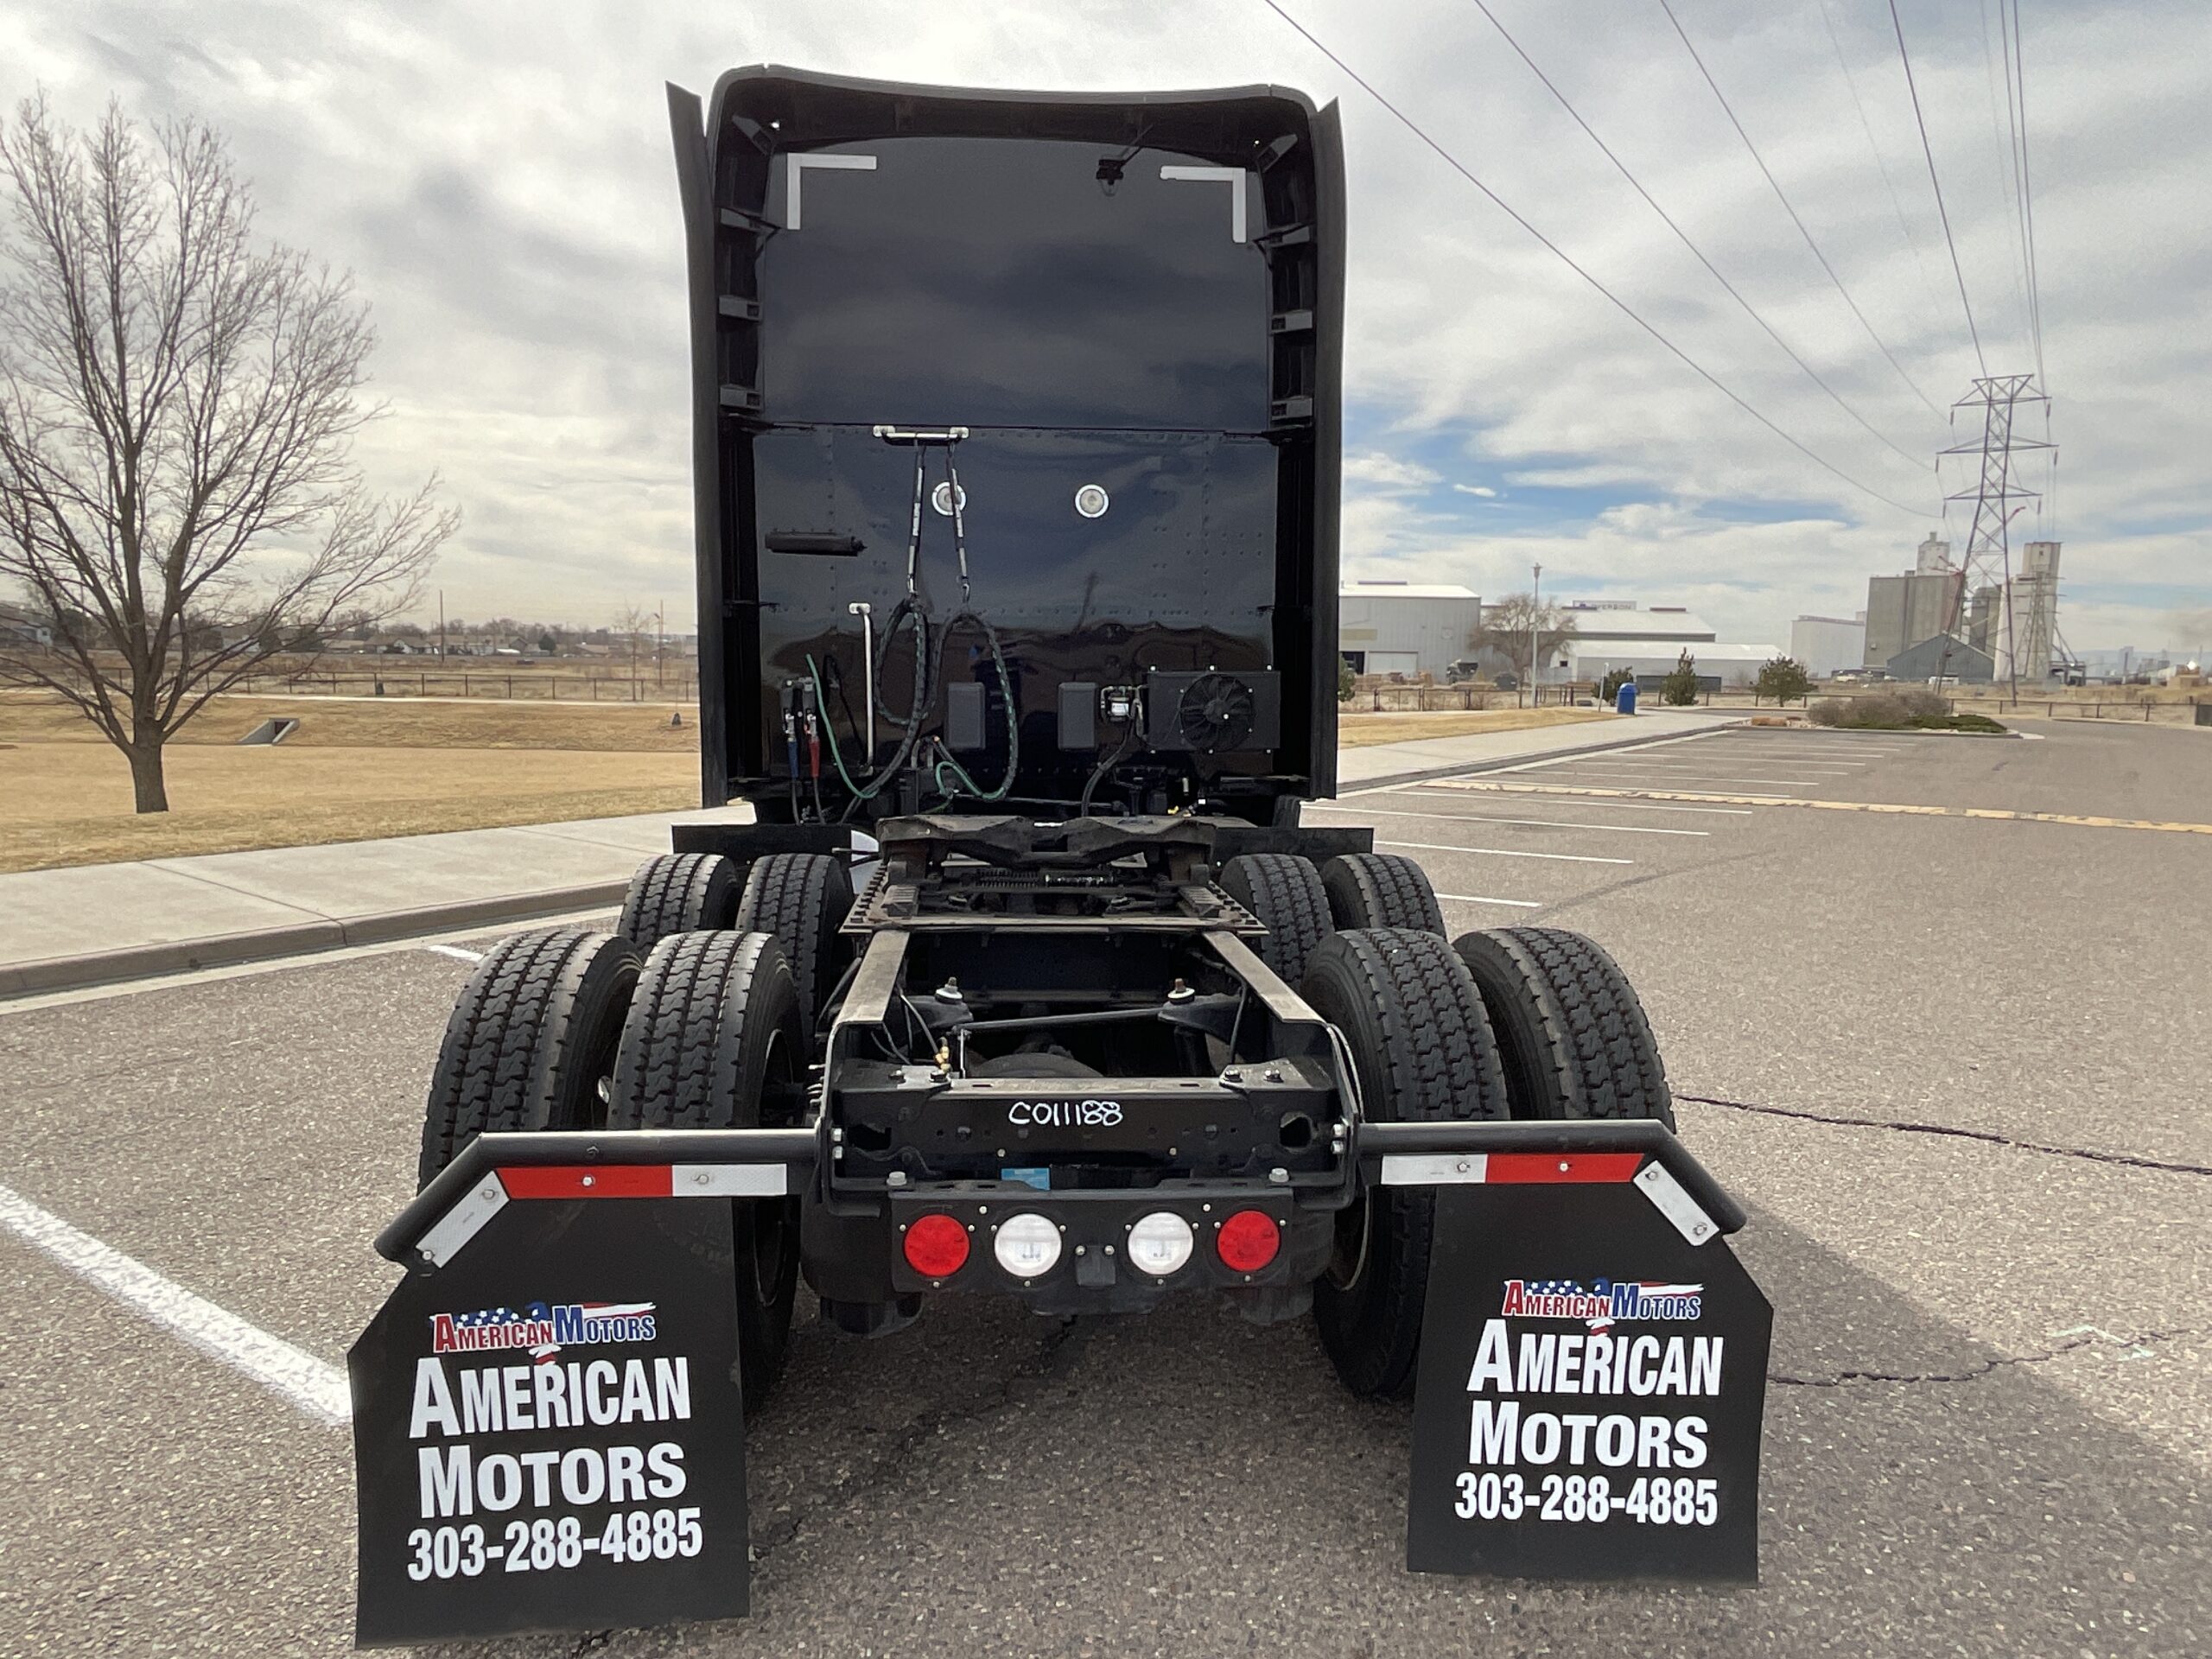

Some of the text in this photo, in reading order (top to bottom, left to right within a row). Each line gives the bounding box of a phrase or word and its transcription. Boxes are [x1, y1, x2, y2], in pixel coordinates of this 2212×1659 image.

[433, 1304, 657, 1353] AMERICAN MOTORS
[1502, 1280, 1700, 1319] AMERICAN MOTORS
[1466, 1319, 1724, 1396] AMERICAN
[409, 1357, 691, 1439] AMERICAN
[1468, 1400, 1708, 1469] MOTORS
[418, 1441, 687, 1519] MOTORS
[1454, 1471, 1718, 1526] 303-288-4885
[407, 1507, 703, 1582] 303-288-4885
